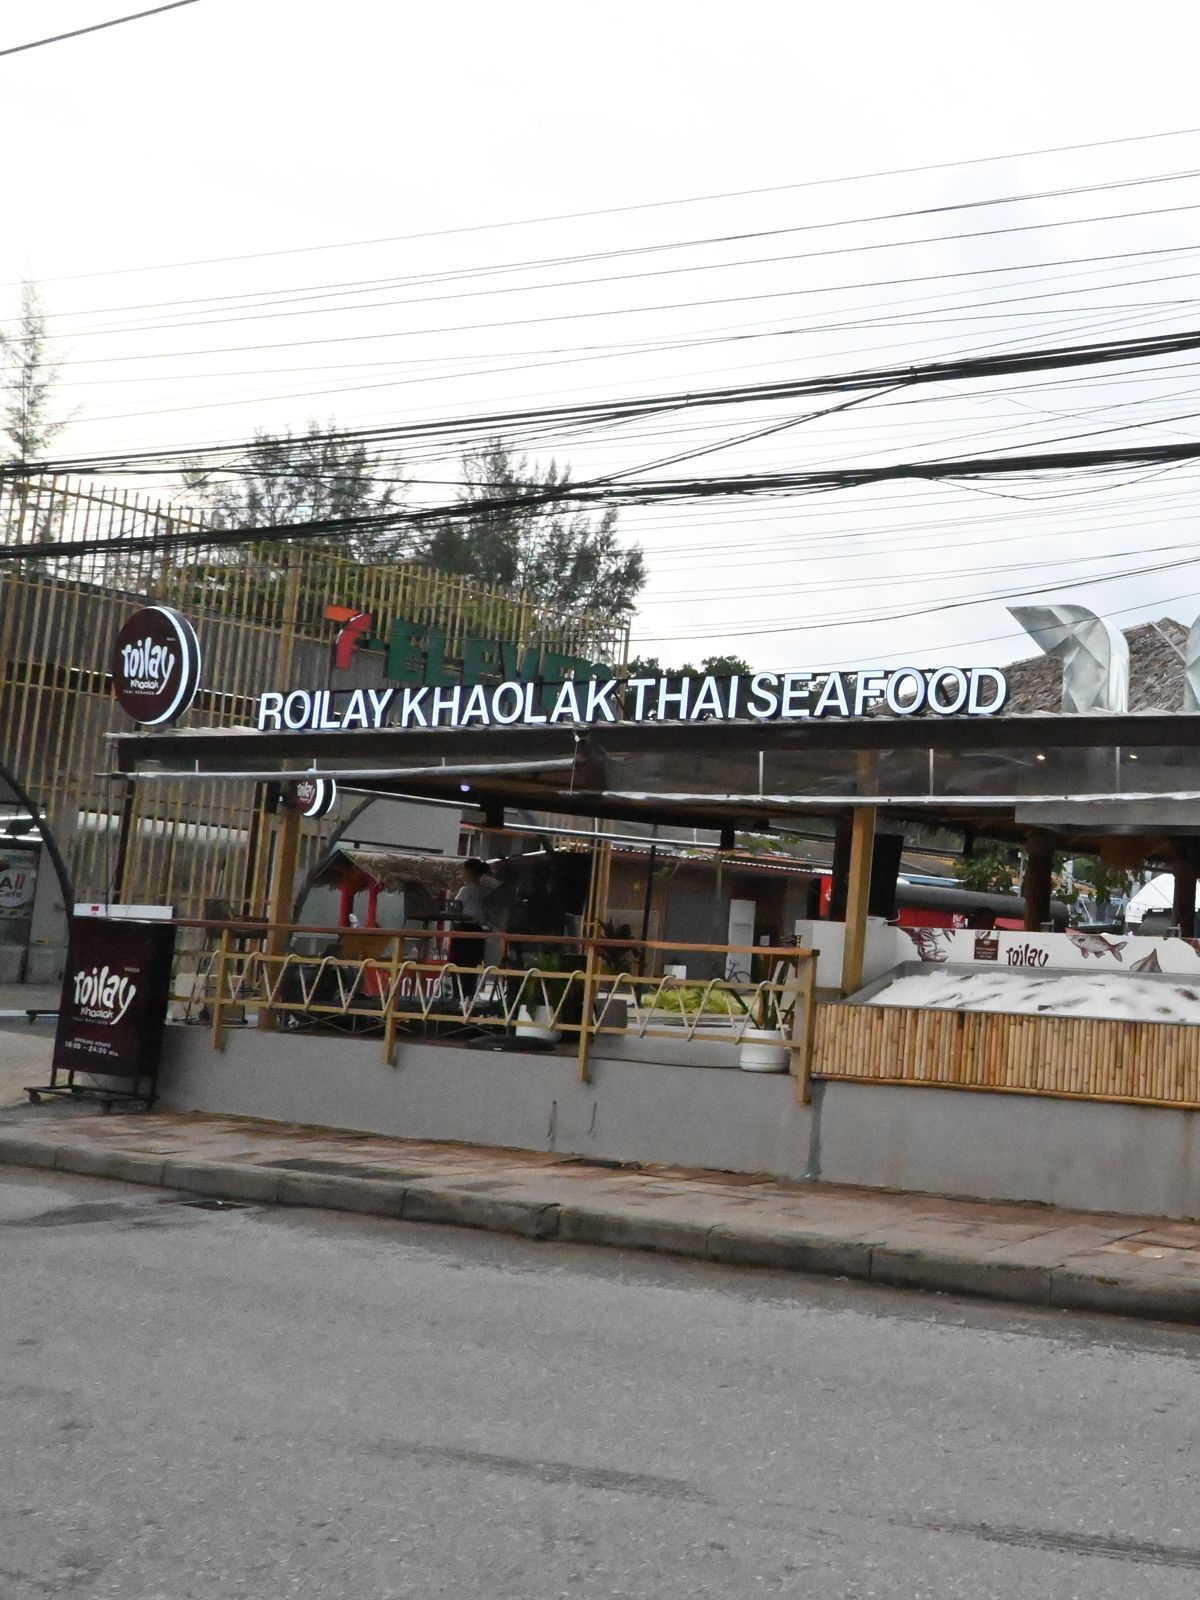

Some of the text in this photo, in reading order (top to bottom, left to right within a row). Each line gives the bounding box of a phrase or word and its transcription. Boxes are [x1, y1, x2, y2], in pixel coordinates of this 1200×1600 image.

[258, 666, 1009, 731] ROILAY KHAOLAK THAI SEAFOOD
